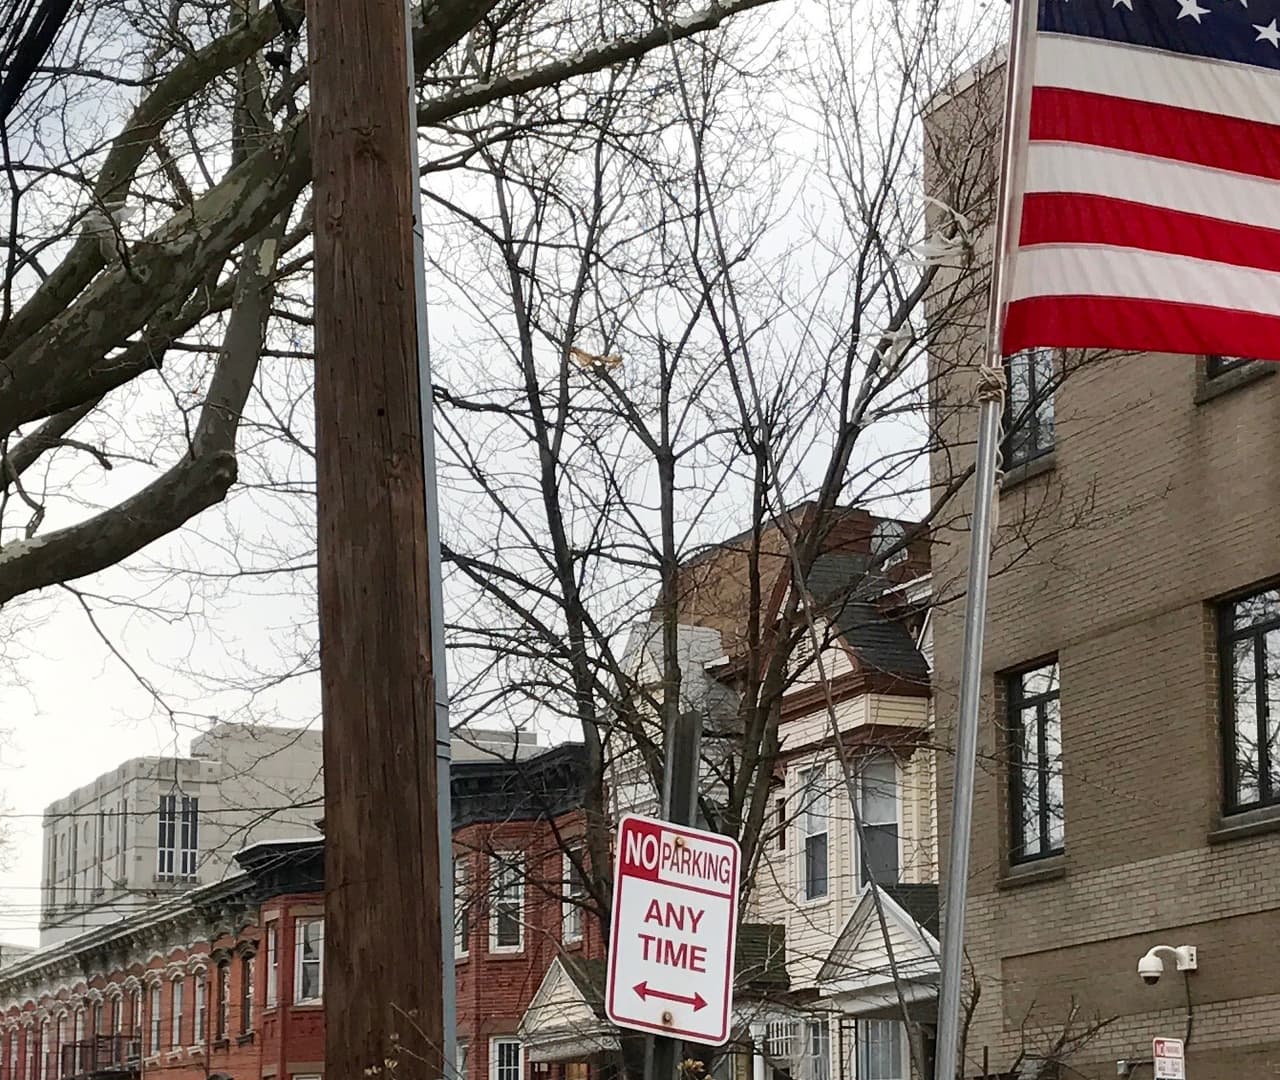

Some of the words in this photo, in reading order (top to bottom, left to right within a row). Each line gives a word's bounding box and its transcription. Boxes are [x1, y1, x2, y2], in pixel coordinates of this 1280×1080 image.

[625, 830, 659, 871] NO
[661, 843, 731, 885] PARKING
[644, 898, 705, 934] ANY
[637, 933, 708, 974] TIME
